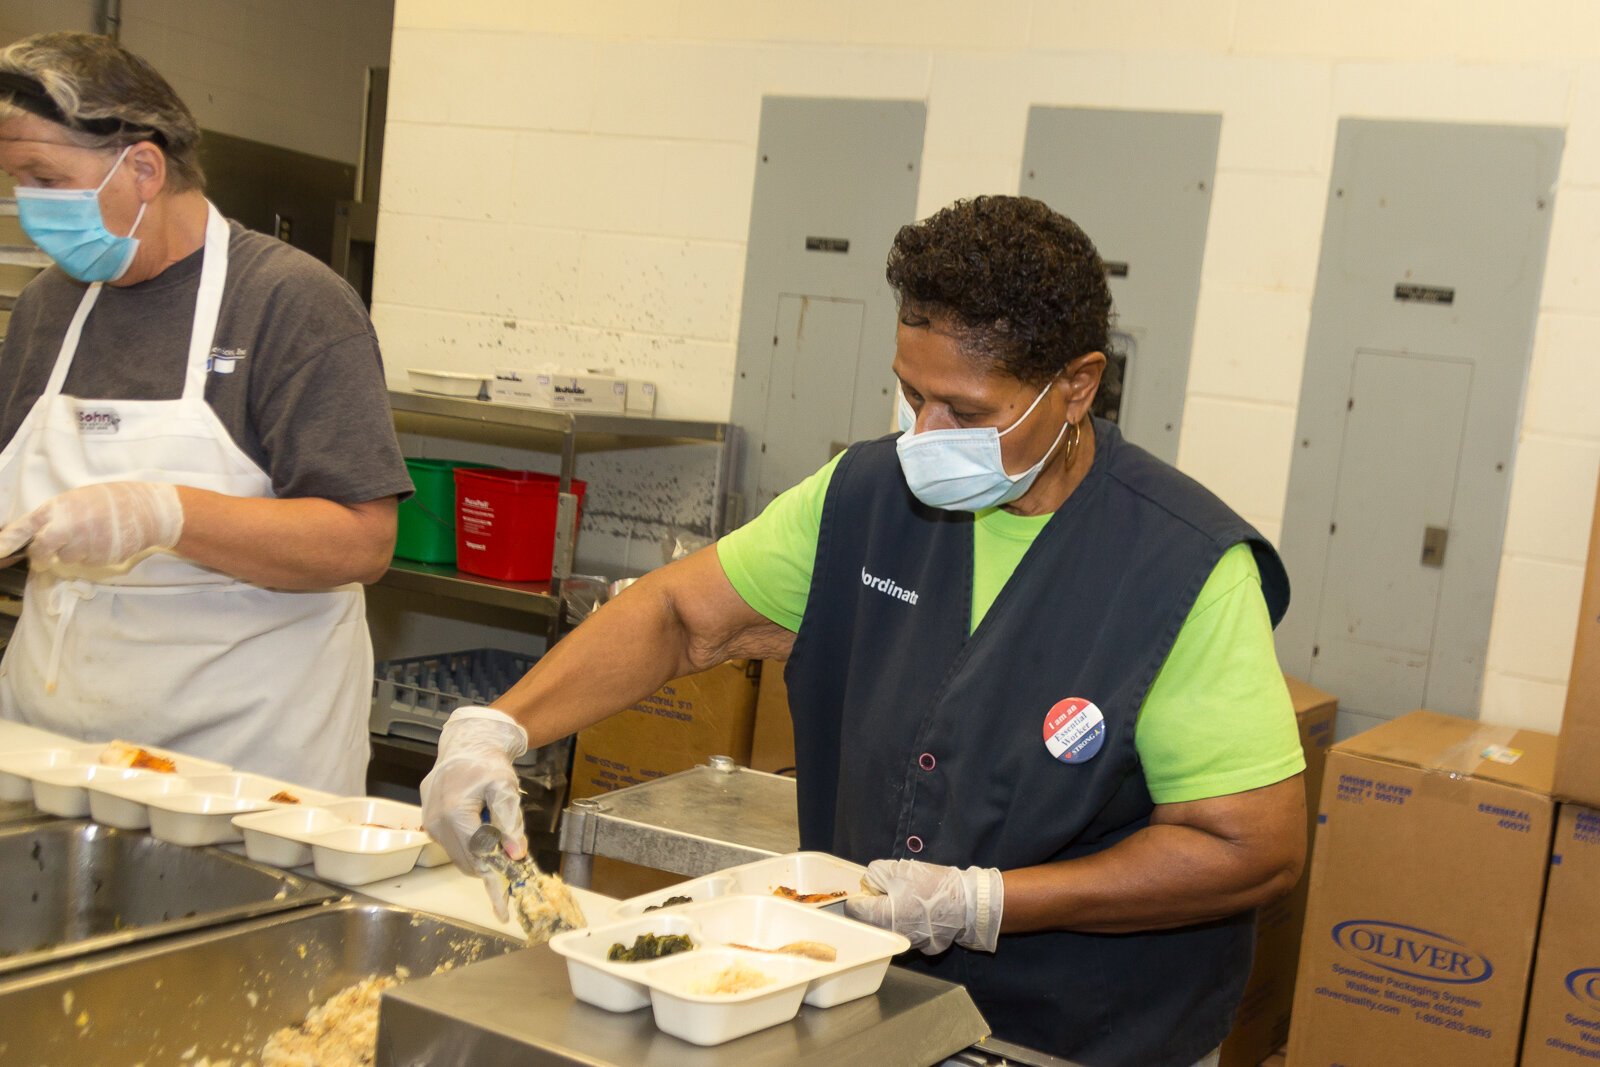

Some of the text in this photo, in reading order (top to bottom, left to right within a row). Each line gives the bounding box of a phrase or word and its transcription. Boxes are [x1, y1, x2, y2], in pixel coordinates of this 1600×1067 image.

[1048, 704, 1078, 730] I am an
[1054, 711, 1088, 742] Essential
[1061, 722, 1090, 747] Worker
[1071, 733, 1096, 755] STRONG
[1350, 928, 1472, 977] OLIVER
[1314, 986, 1400, 1015] oliverquality.com
[1384, 989, 1431, 1011] Michigan
[1386, 977, 1440, 1000] Packaging
[1442, 990, 1483, 1009] System
